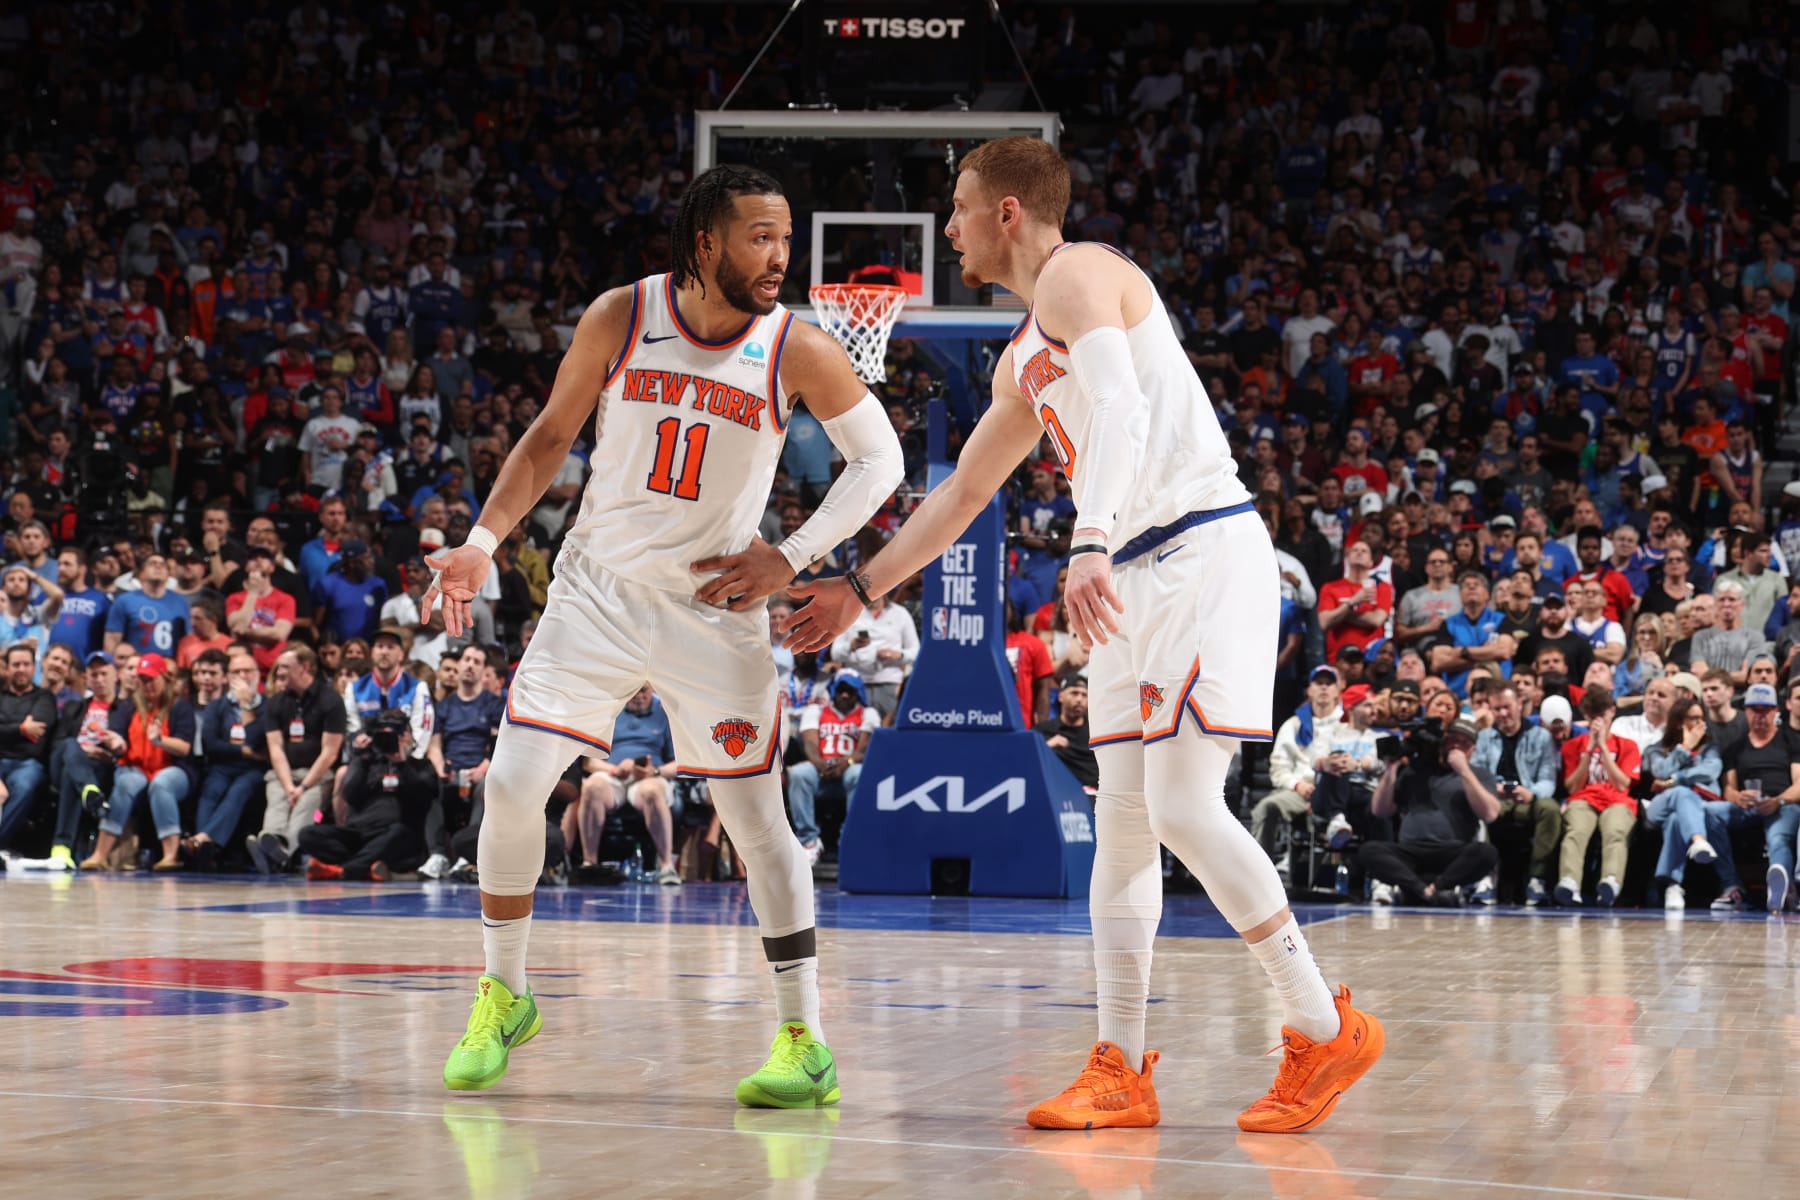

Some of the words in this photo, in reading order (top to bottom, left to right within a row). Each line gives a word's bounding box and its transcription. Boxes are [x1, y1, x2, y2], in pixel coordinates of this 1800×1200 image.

[861, 17, 966, 39] TISSOT
[737, 357, 766, 369] sphere
[622, 368, 690, 406] NEW
[692, 378, 767, 432] YORK
[646, 416, 711, 502] 11
[941, 543, 977, 574] GET
[941, 576, 977, 606] THE
[138, 620, 174, 651] 76
[948, 608, 985, 647] App
[712, 721, 758, 742] KNICKS
[908, 708, 965, 728] Google
[967, 710, 1003, 726] Pixel
[822, 735, 855, 758] 10
[876, 774, 1026, 814] KIA
